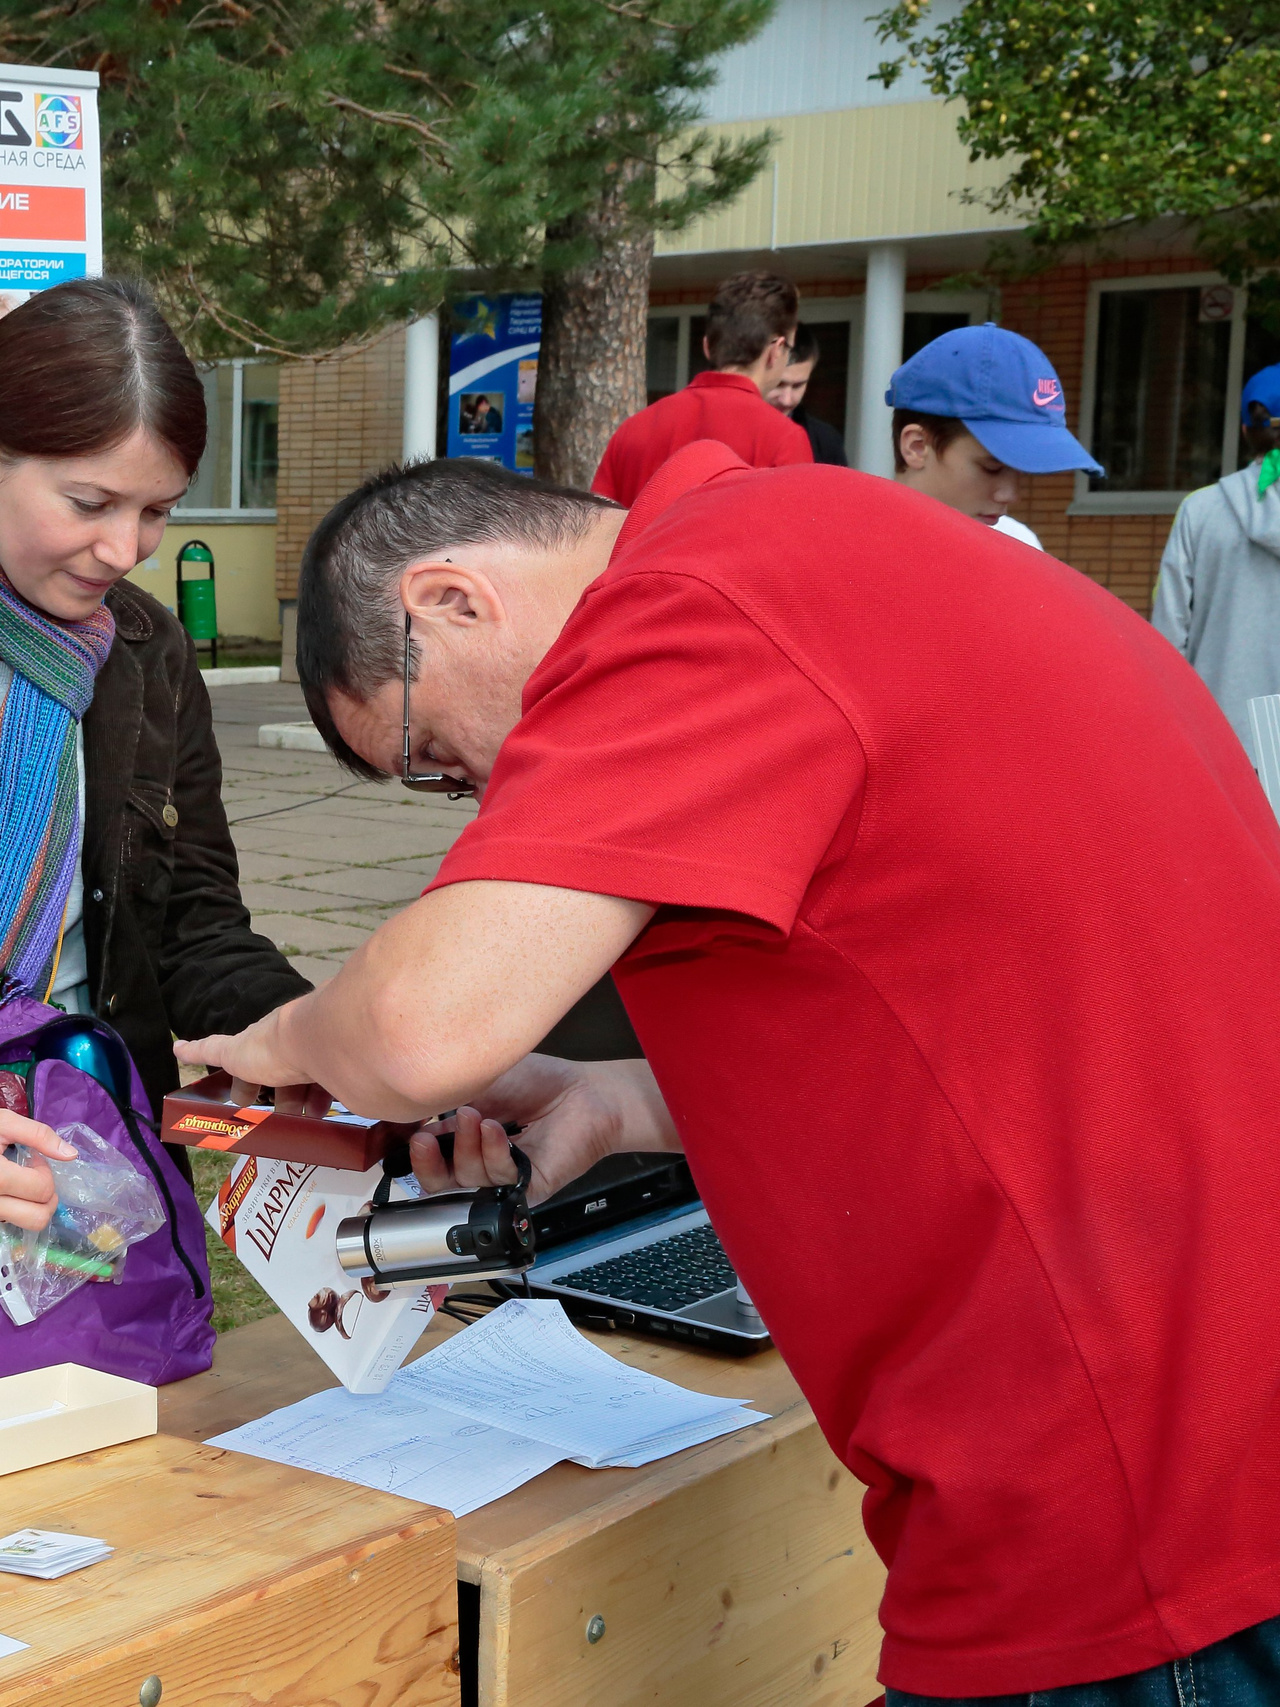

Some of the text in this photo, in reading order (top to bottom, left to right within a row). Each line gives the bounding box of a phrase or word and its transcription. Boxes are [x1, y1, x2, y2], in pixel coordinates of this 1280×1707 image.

[38, 113, 78, 130] AFS
[33, 151, 86, 171] СРЕДА
[1038, 379, 1057, 394] NIKE
[241, 1174, 273, 1224] ЗЕФИРЧИКИ
[287, 1180, 318, 1230] КЛАССИЧЕСКИЕ
[585, 1198, 607, 1213] ASUS
